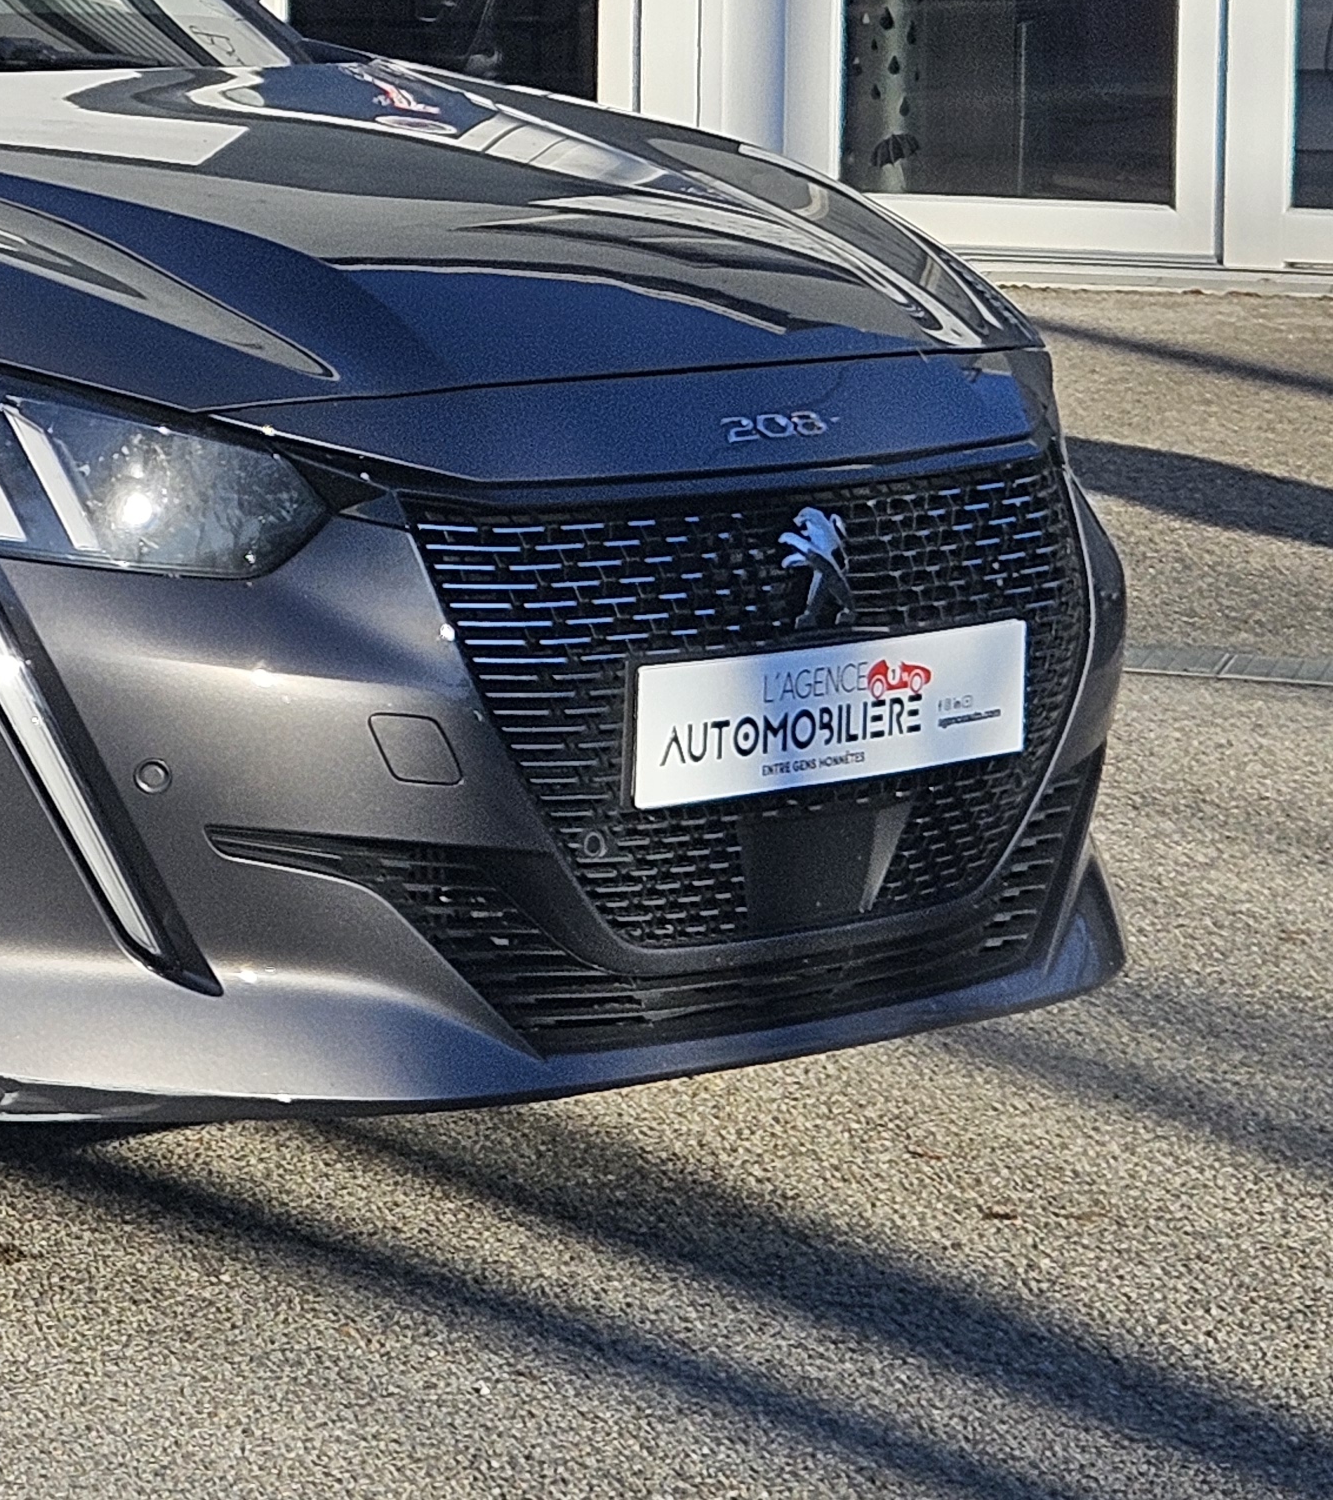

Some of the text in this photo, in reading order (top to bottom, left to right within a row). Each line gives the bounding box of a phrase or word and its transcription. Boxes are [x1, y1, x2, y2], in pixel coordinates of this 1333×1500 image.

[719, 410, 828, 444] 208
[762, 661, 870, 704] L'AGENCE
[761, 761, 791, 777] ENTRE
[792, 758, 818, 773] GENS
